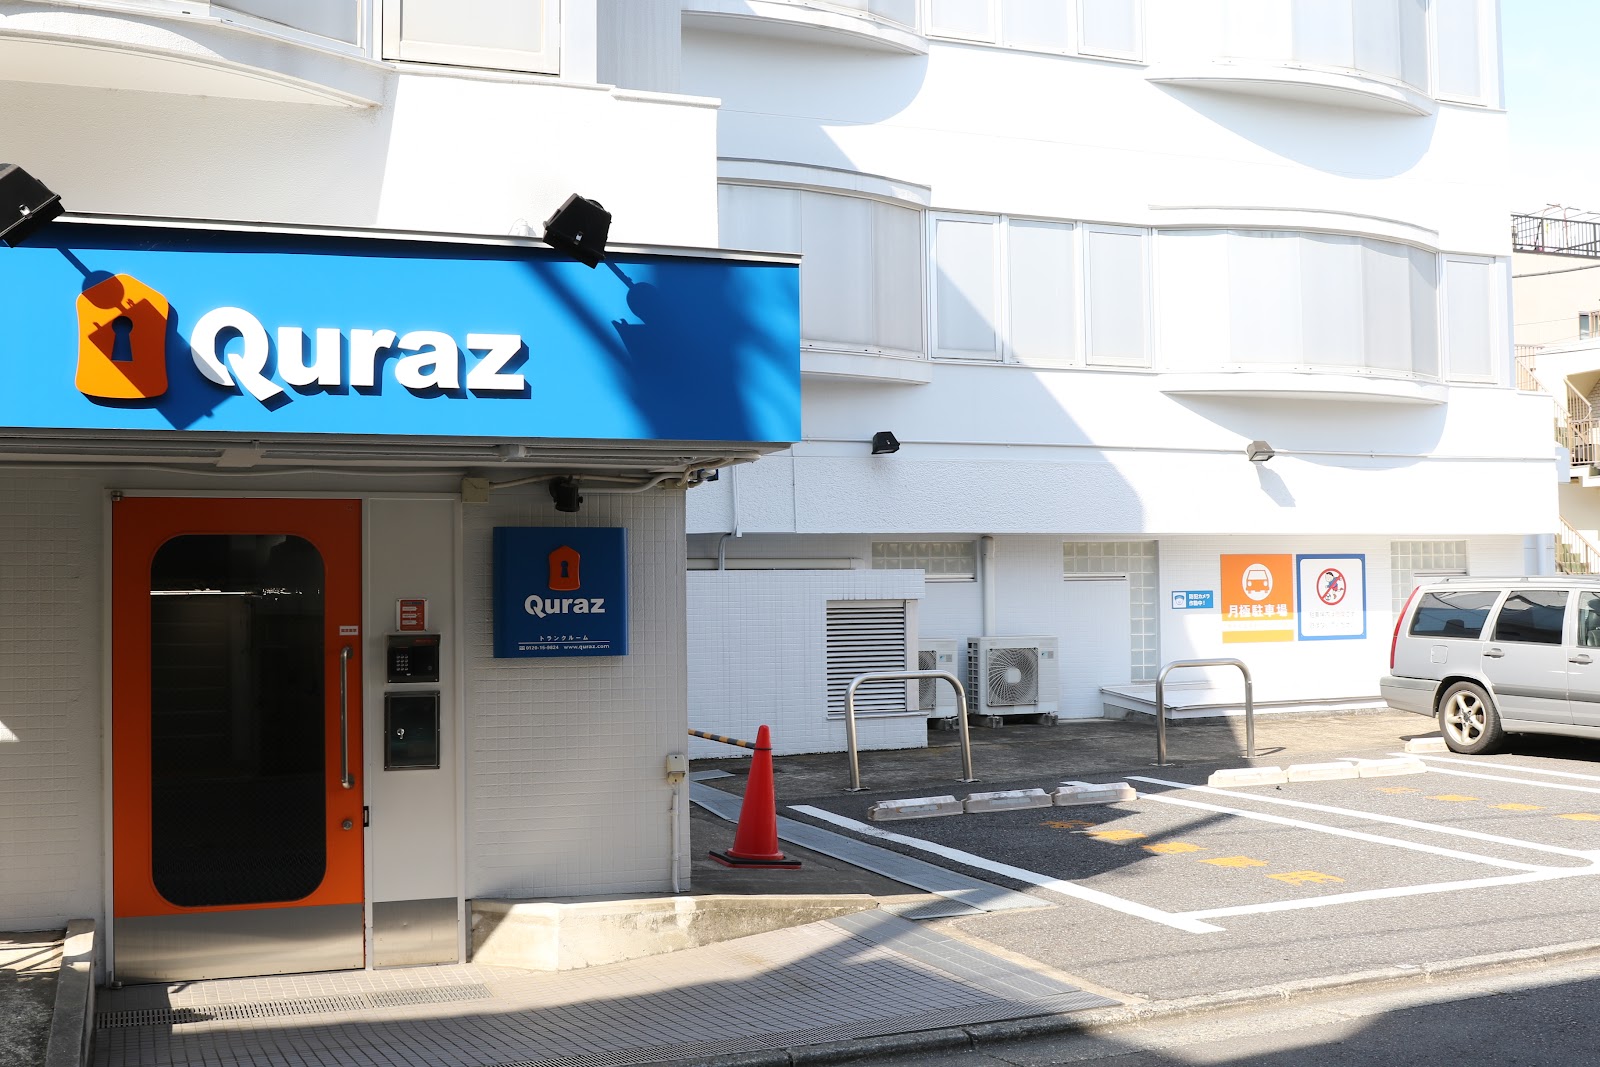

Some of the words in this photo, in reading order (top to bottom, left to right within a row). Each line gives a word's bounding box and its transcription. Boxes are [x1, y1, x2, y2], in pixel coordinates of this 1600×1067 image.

[190, 306, 526, 403] Quraz
[524, 594, 606, 619] Quraz
[1228, 604, 1288, 618] 月極駐車場
